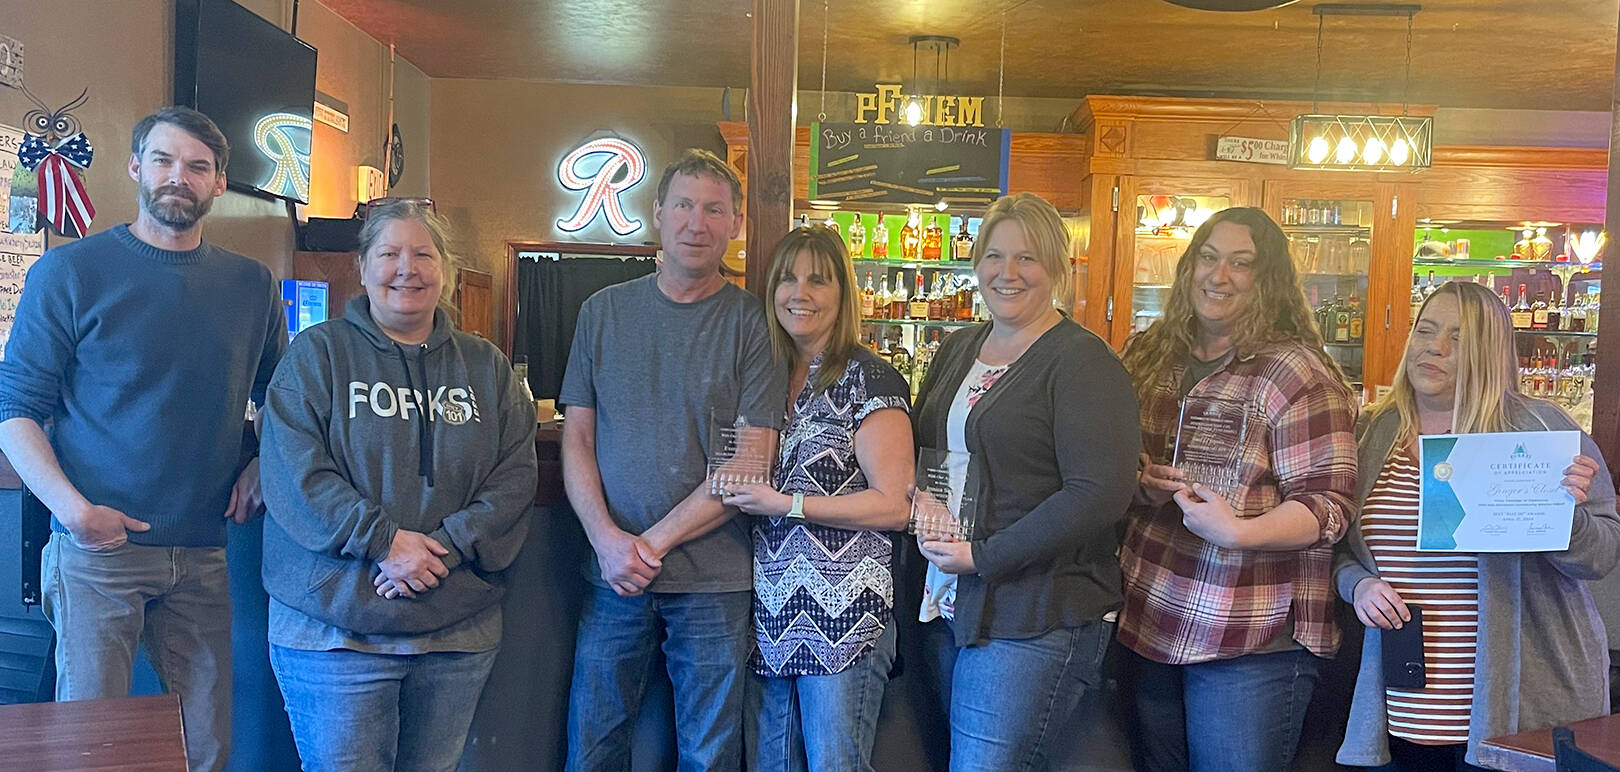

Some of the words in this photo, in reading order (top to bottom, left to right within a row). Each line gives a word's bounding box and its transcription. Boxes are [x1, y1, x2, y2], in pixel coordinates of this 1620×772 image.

[822, 128, 851, 150] Buy
[859, 128, 866, 139] a
[873, 125, 916, 144] friend
[923, 129, 933, 142] a
[940, 127, 987, 147] Drink
[557, 138, 645, 236] R
[349, 381, 473, 424] FORKS
[446, 410, 463, 422] 101
